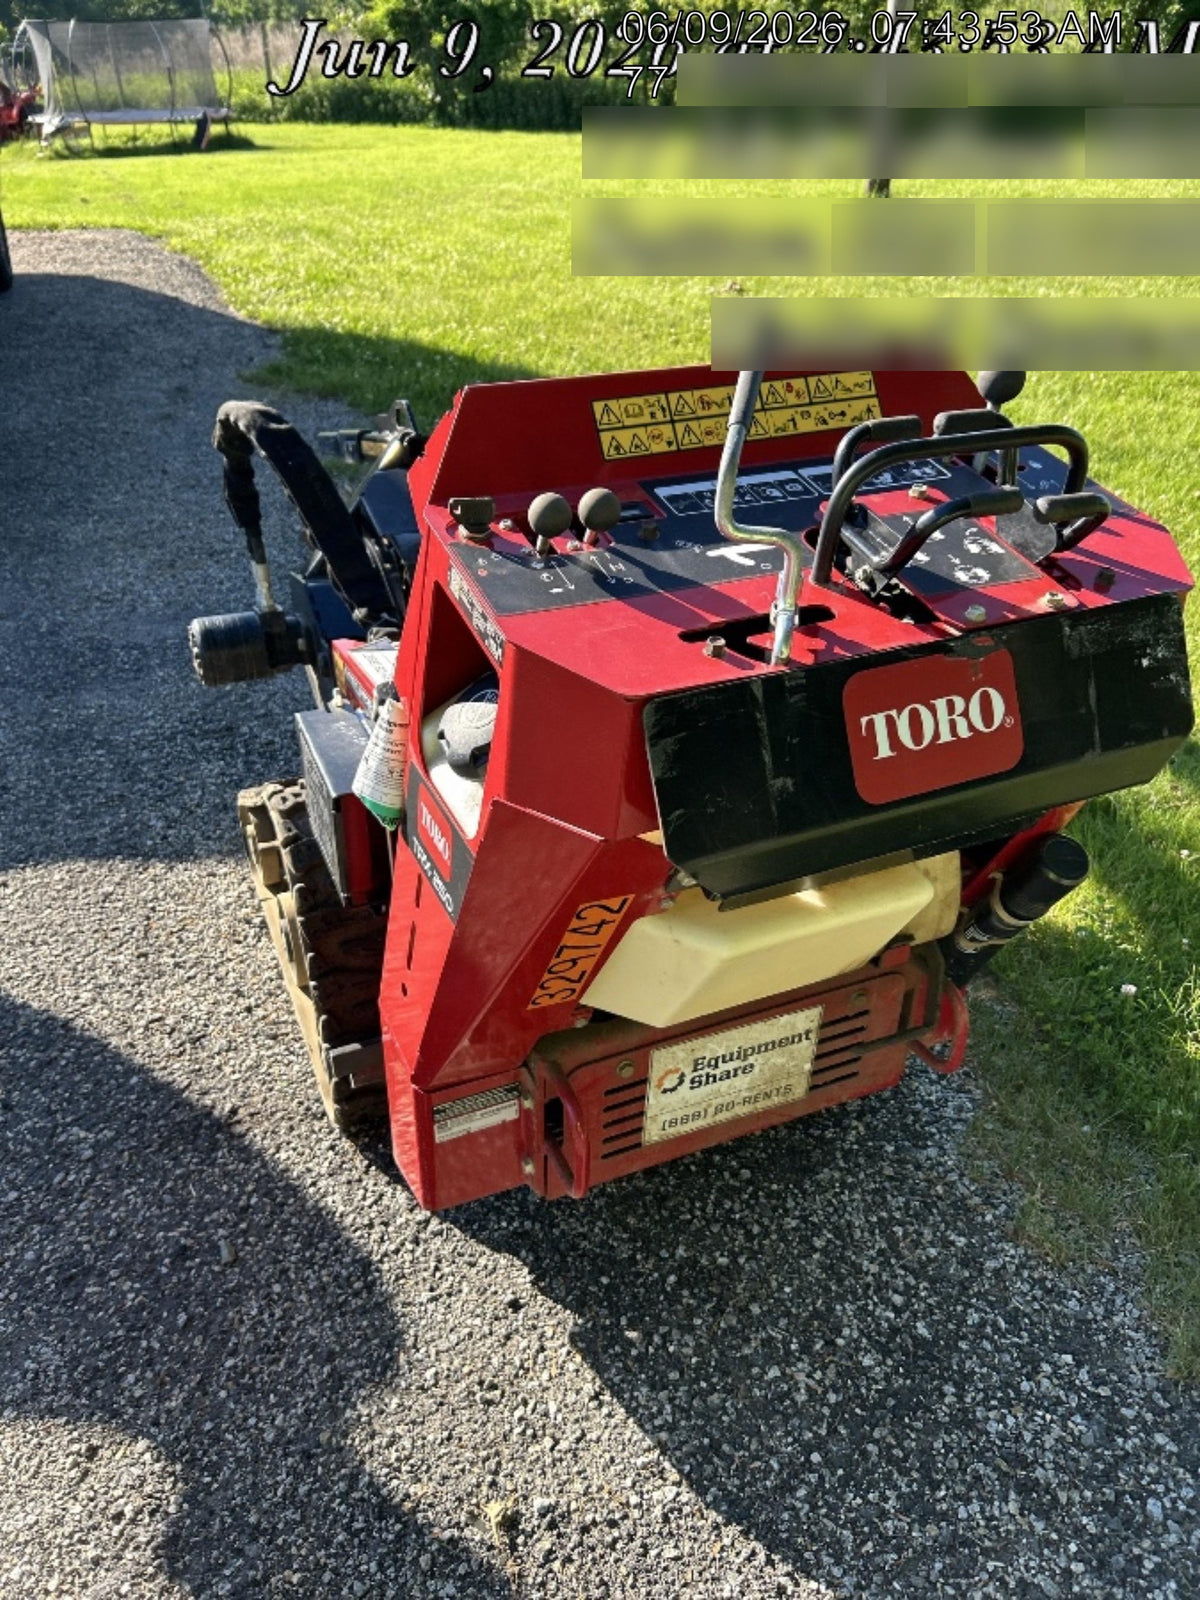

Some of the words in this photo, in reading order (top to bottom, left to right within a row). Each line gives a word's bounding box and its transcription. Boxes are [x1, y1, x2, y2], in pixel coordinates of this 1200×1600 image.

[860, 687, 1005, 760] TORO
[530, 896, 629, 1006] 329742
[688, 1062, 755, 1091] Share
[691, 1028, 813, 1074] Equipment
